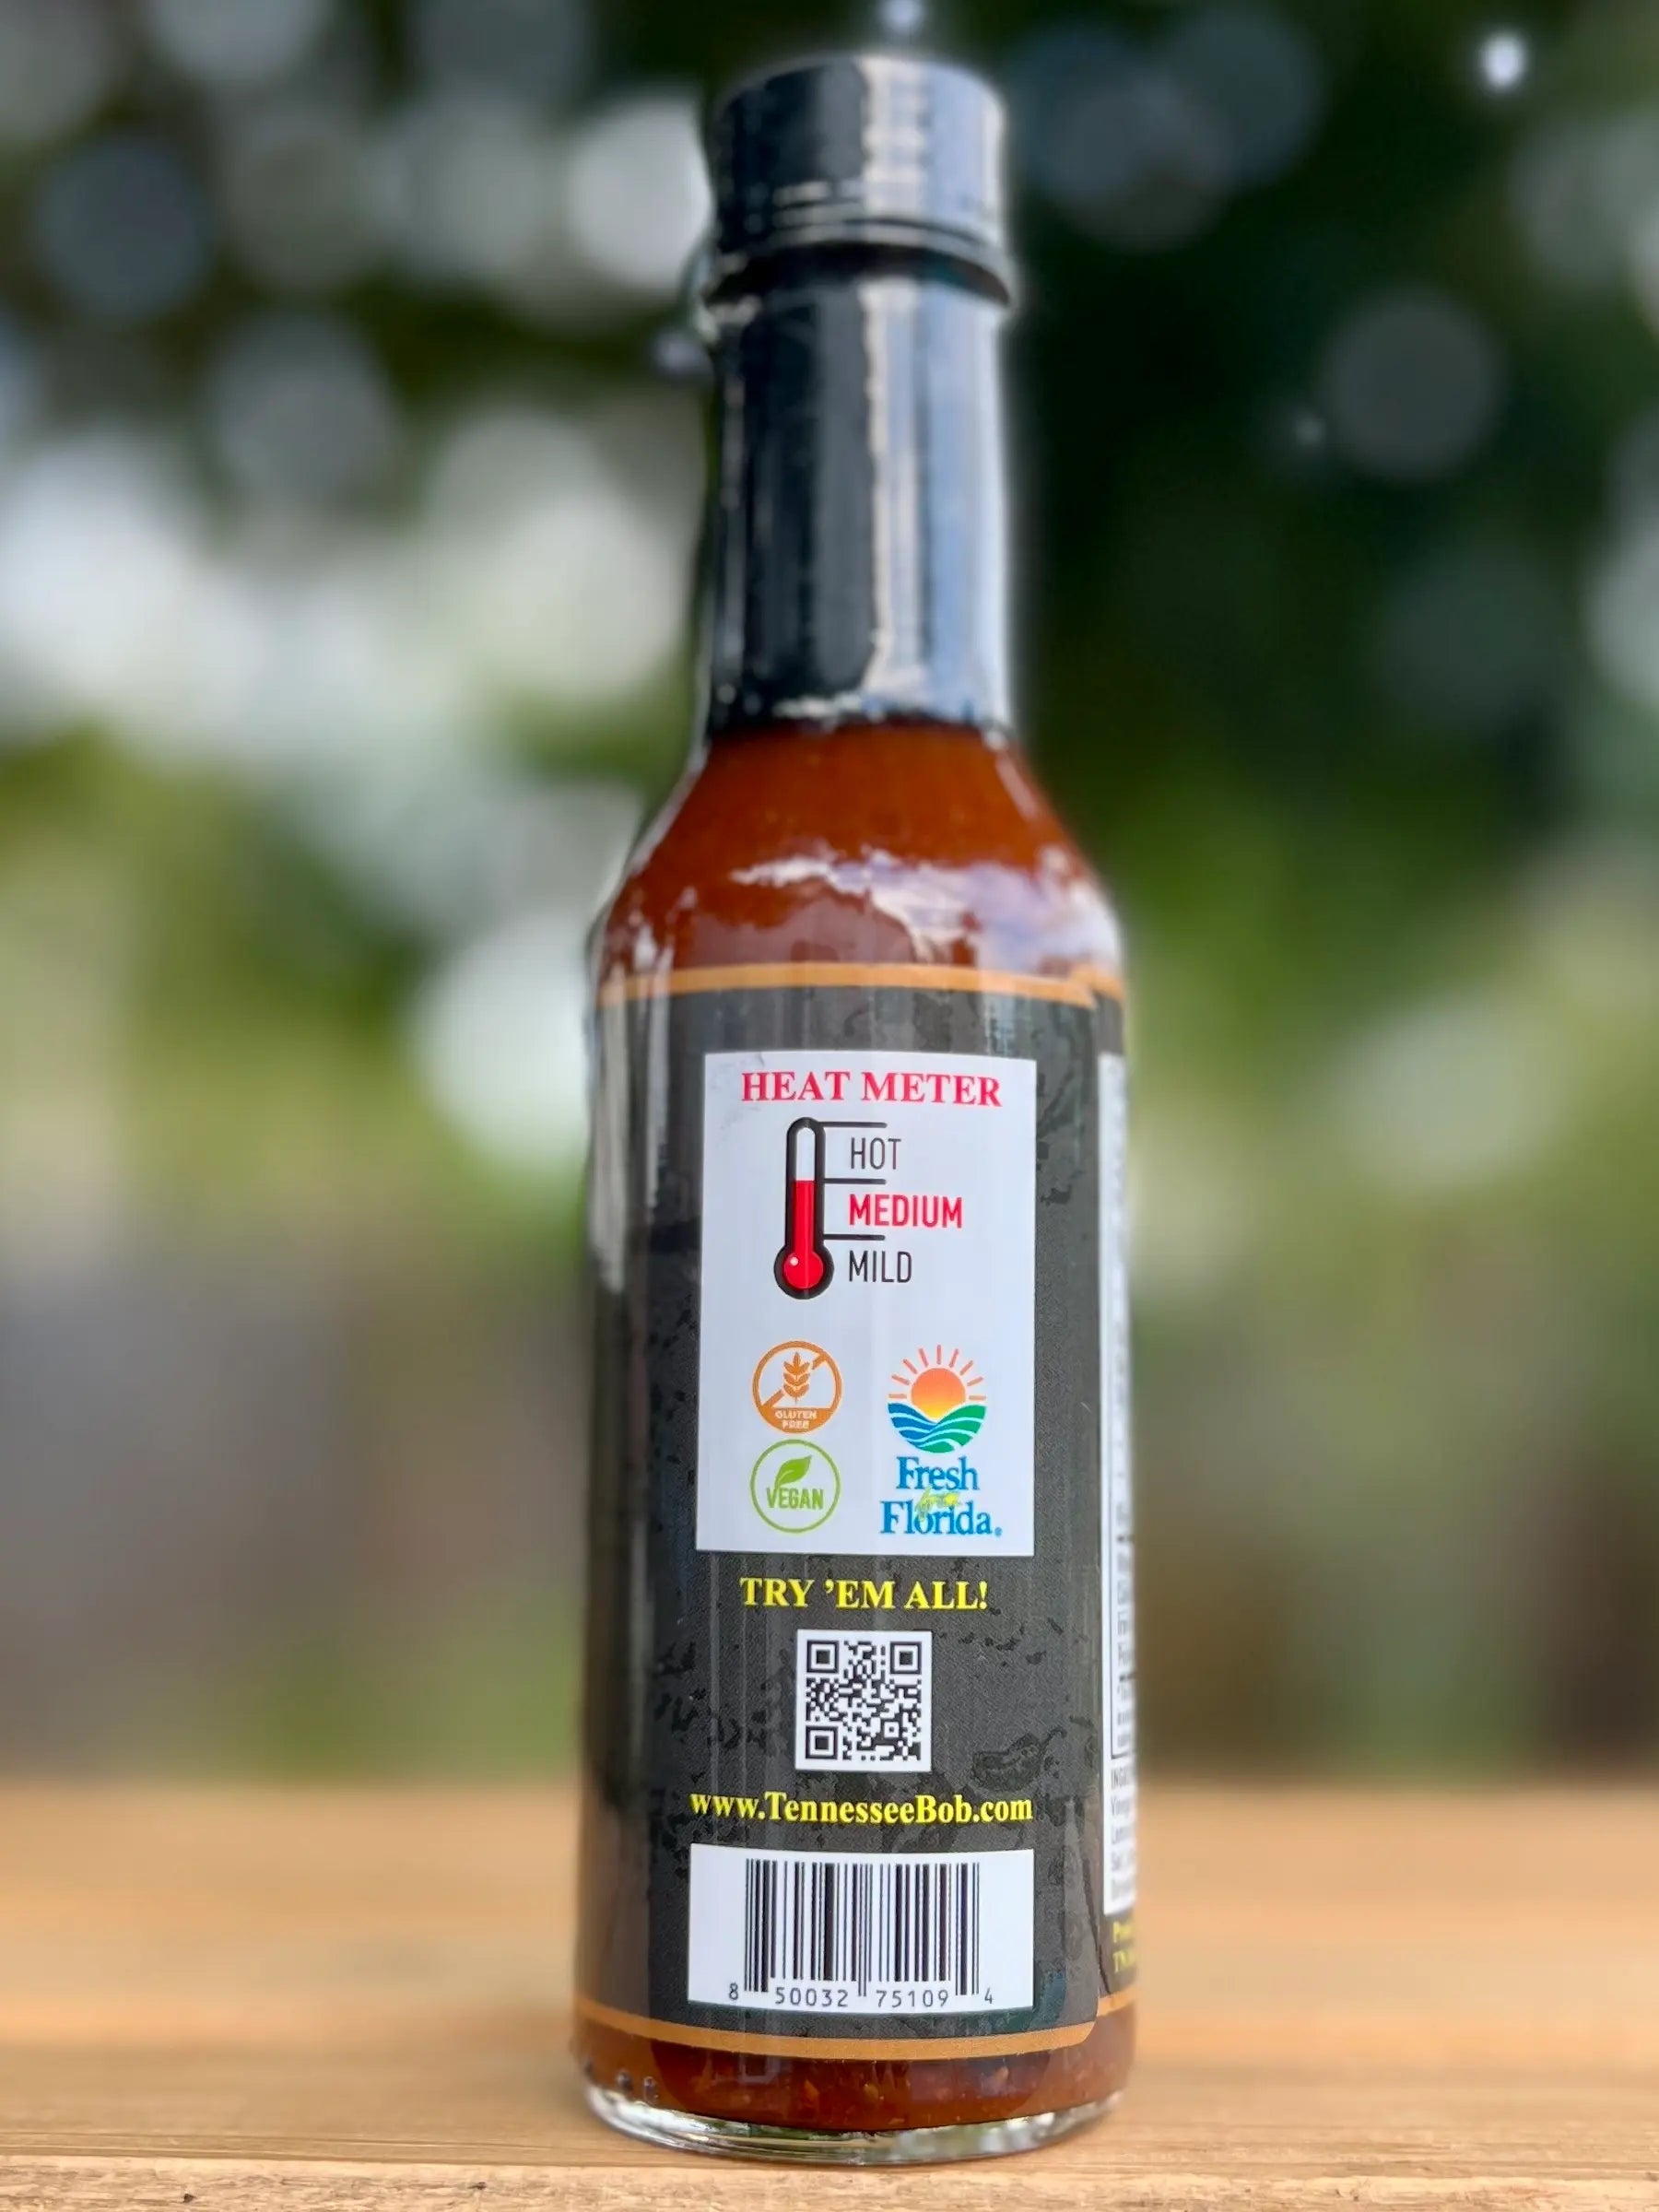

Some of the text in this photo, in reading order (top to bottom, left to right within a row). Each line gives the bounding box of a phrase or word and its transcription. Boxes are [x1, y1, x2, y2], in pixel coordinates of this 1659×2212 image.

[741, 1071, 1003, 1107] HEAT METER
[849, 1136, 902, 1171] HOT
[848, 1194, 963, 1229] MEDIUM
[848, 1250, 912, 1283] MILD
[774, 1409, 818, 1420] GLUTEN
[782, 1419, 810, 1430] FREE
[895, 1454, 981, 1490] Fresh
[766, 1487, 824, 1510] VEGAN
[739, 1576, 989, 1610] TRY ’EM ALL!
[689, 1791, 1033, 1823] www.TennesseeBob.com
[728, 1983, 994, 2007] 8 50032 75109 4
